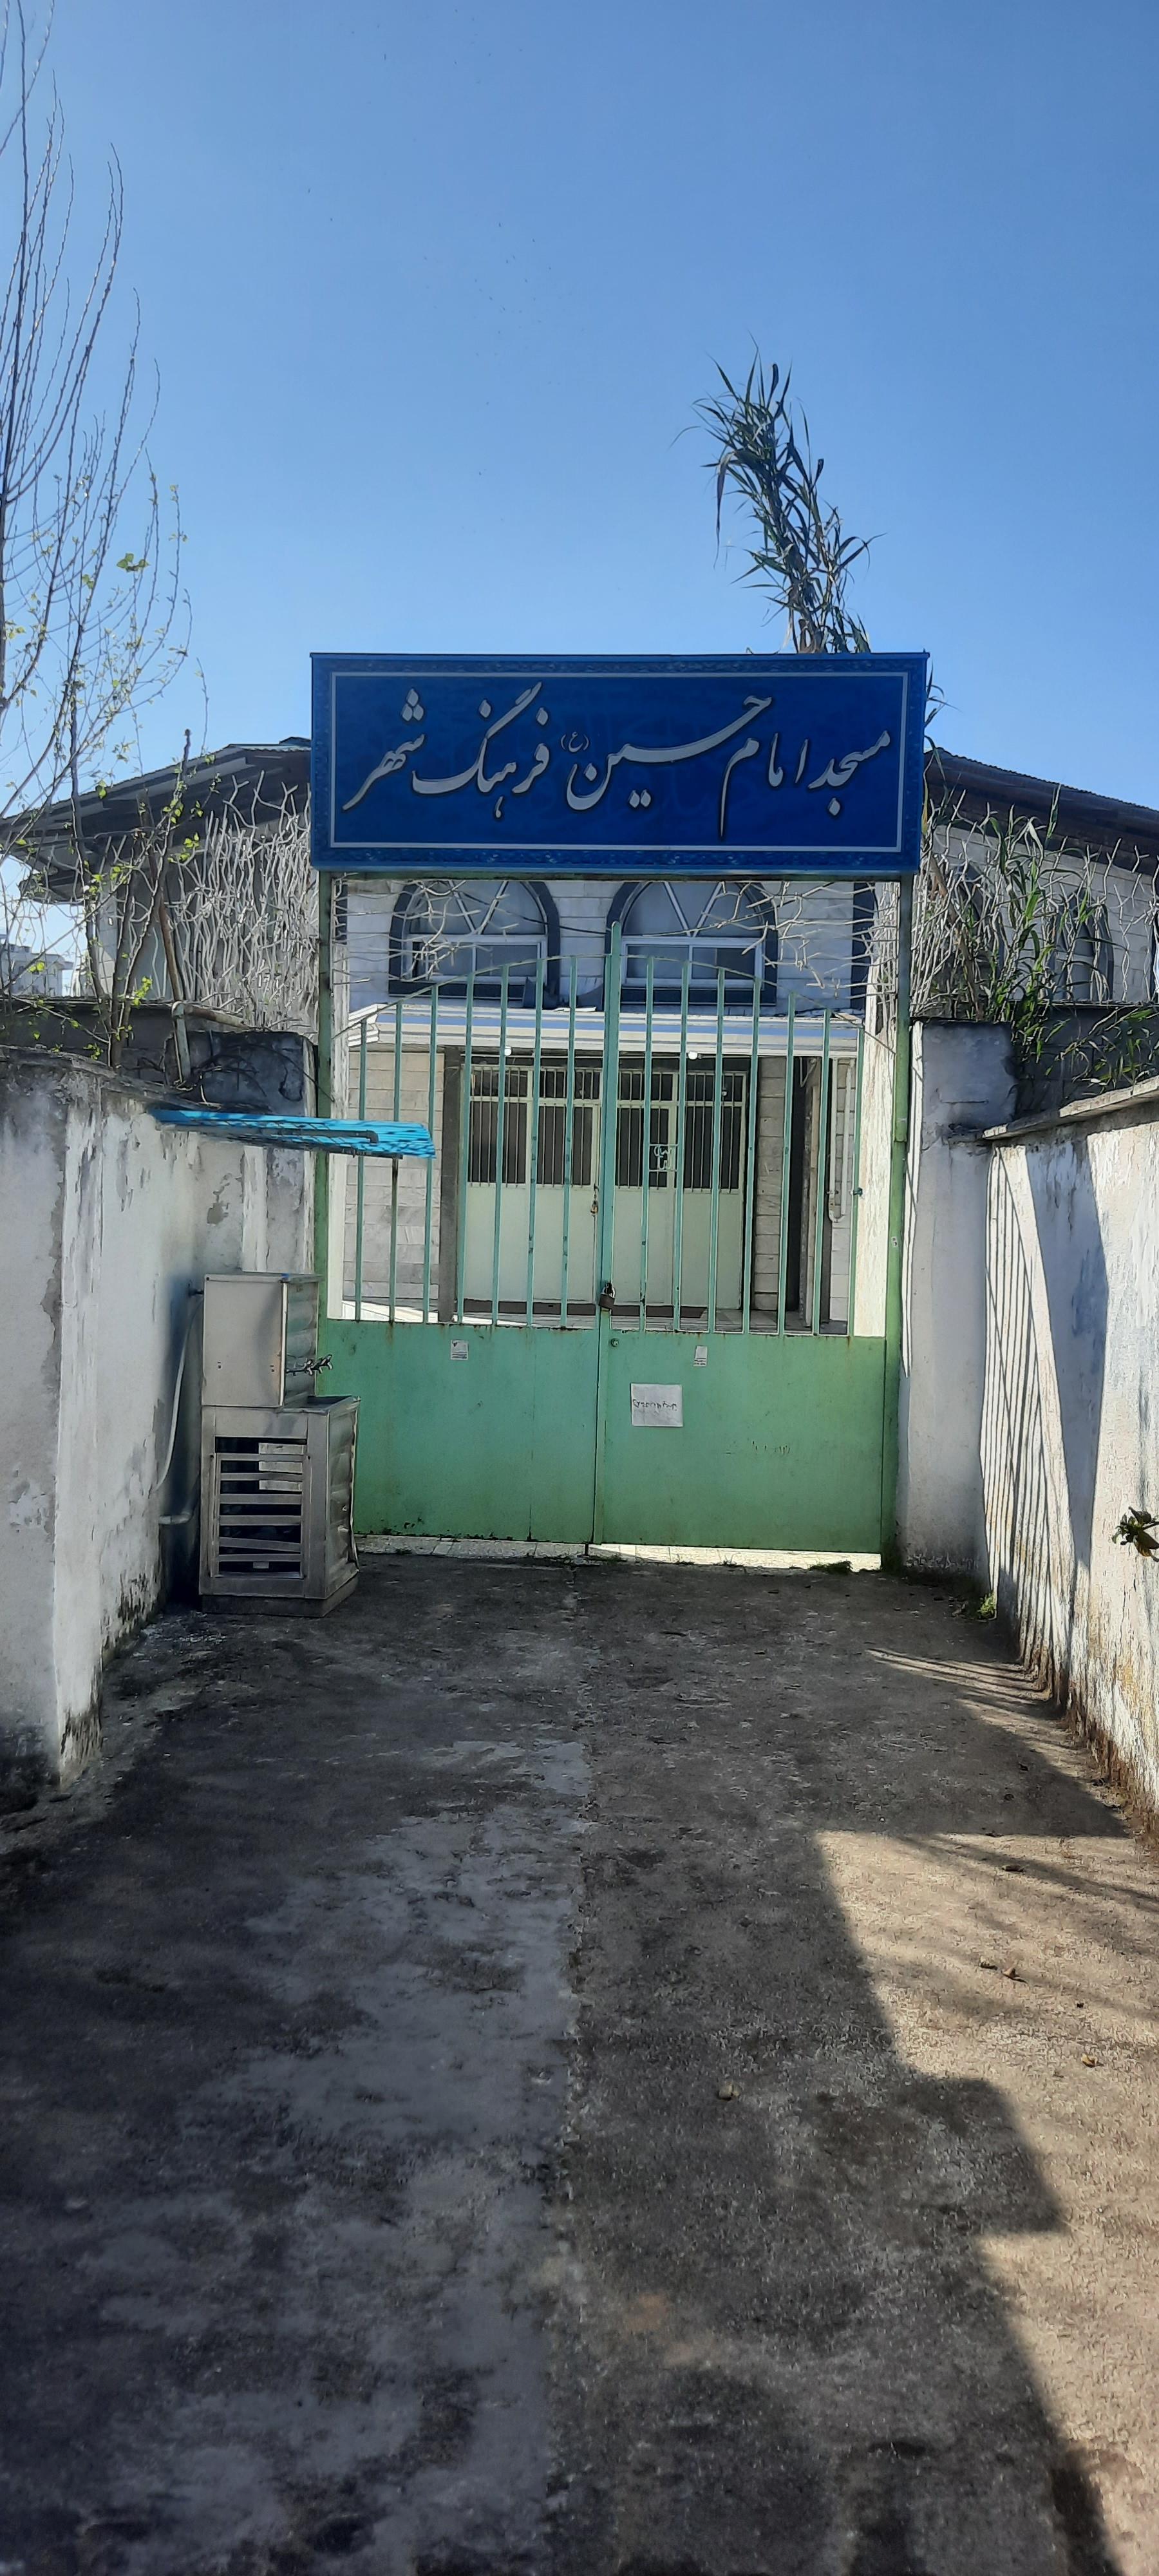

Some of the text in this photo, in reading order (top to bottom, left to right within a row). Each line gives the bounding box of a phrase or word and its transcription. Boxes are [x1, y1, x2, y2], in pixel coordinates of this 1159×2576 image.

[341, 688, 426, 811] شهر
[411, 681, 550, 819] فرهنگ
[566, 694, 773, 811] حسین
[719, 732, 809, 838] امام
[807, 730, 890, 817] مسجد
